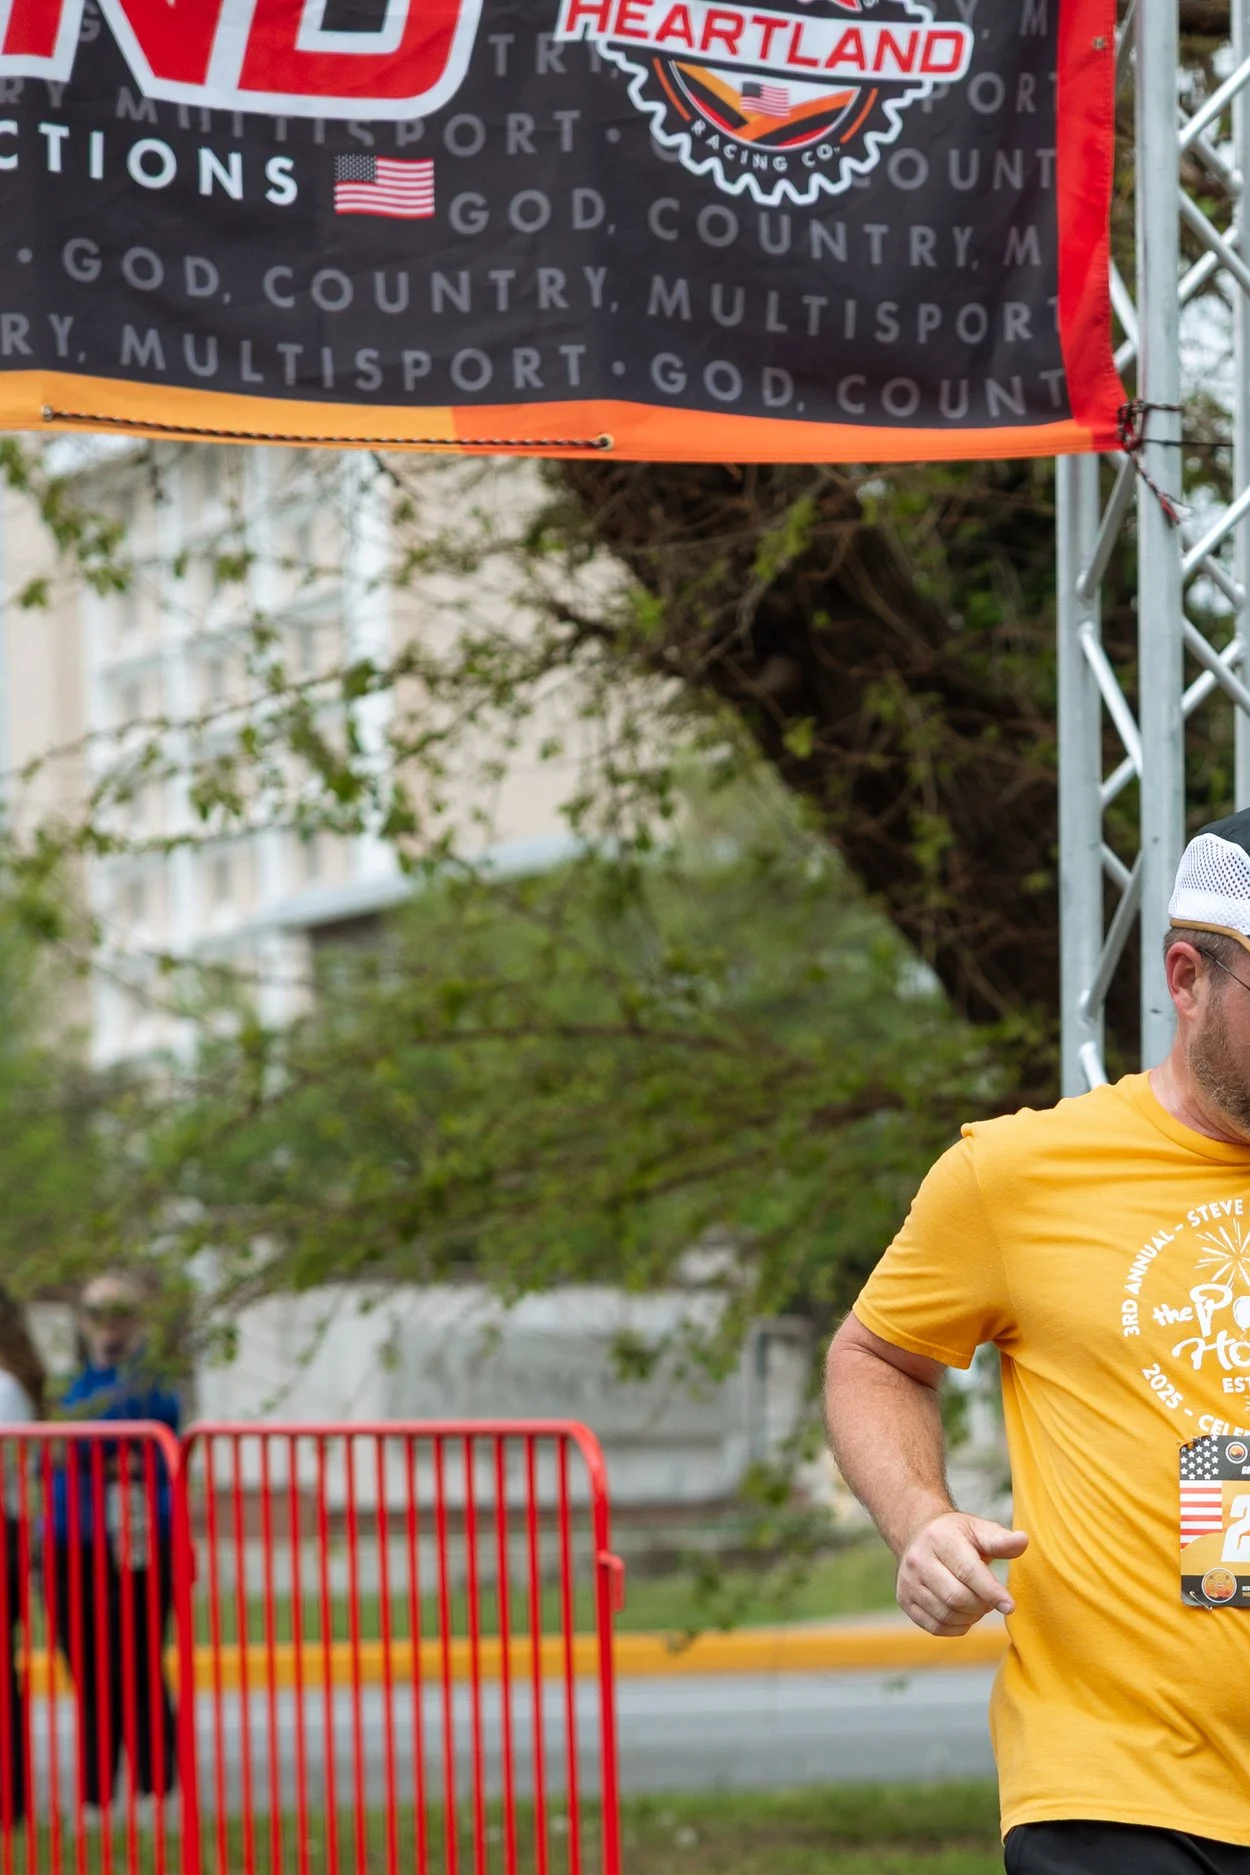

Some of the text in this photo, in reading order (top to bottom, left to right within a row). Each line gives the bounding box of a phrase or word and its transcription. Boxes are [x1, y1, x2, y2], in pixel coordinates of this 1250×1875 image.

[562, 0, 966, 74] HEARTLAND
[691, 118, 788, 172] RACING
[449, 187, 615, 235] GOD,
[648, 199, 980, 270] COUNTRY,
[62, 238, 1061, 345] GOD, COUNTRY, MULTISPOR
[121, 324, 586, 391] MULTISPORT
[1186, 1199, 1244, 1227] STEVE
[1123, 1229, 1175, 1296] ANNUAL
[1121, 1298, 1140, 1337] 3RD
[1152, 1303, 1194, 1327] the
[1141, 1362, 1184, 1410] 2025
